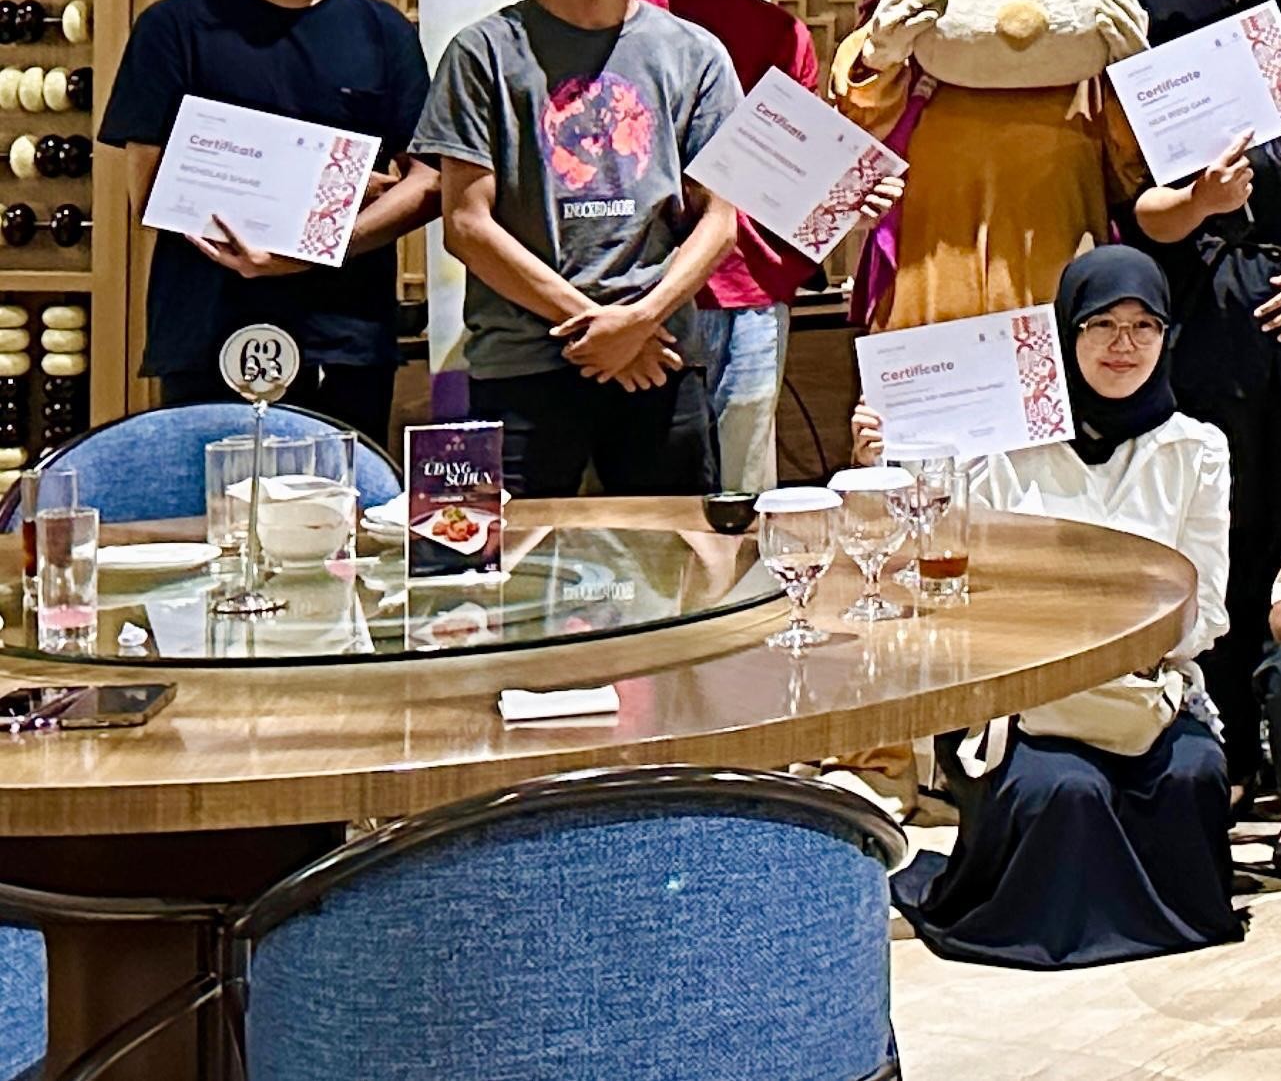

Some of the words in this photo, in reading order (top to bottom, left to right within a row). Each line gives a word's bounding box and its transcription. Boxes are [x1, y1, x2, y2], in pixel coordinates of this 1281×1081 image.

[1136, 70, 1201, 103] Certificate
[188, 133, 264, 160] Certificate
[240, 338, 282, 382] 63
[880, 359, 955, 384] Certificate
